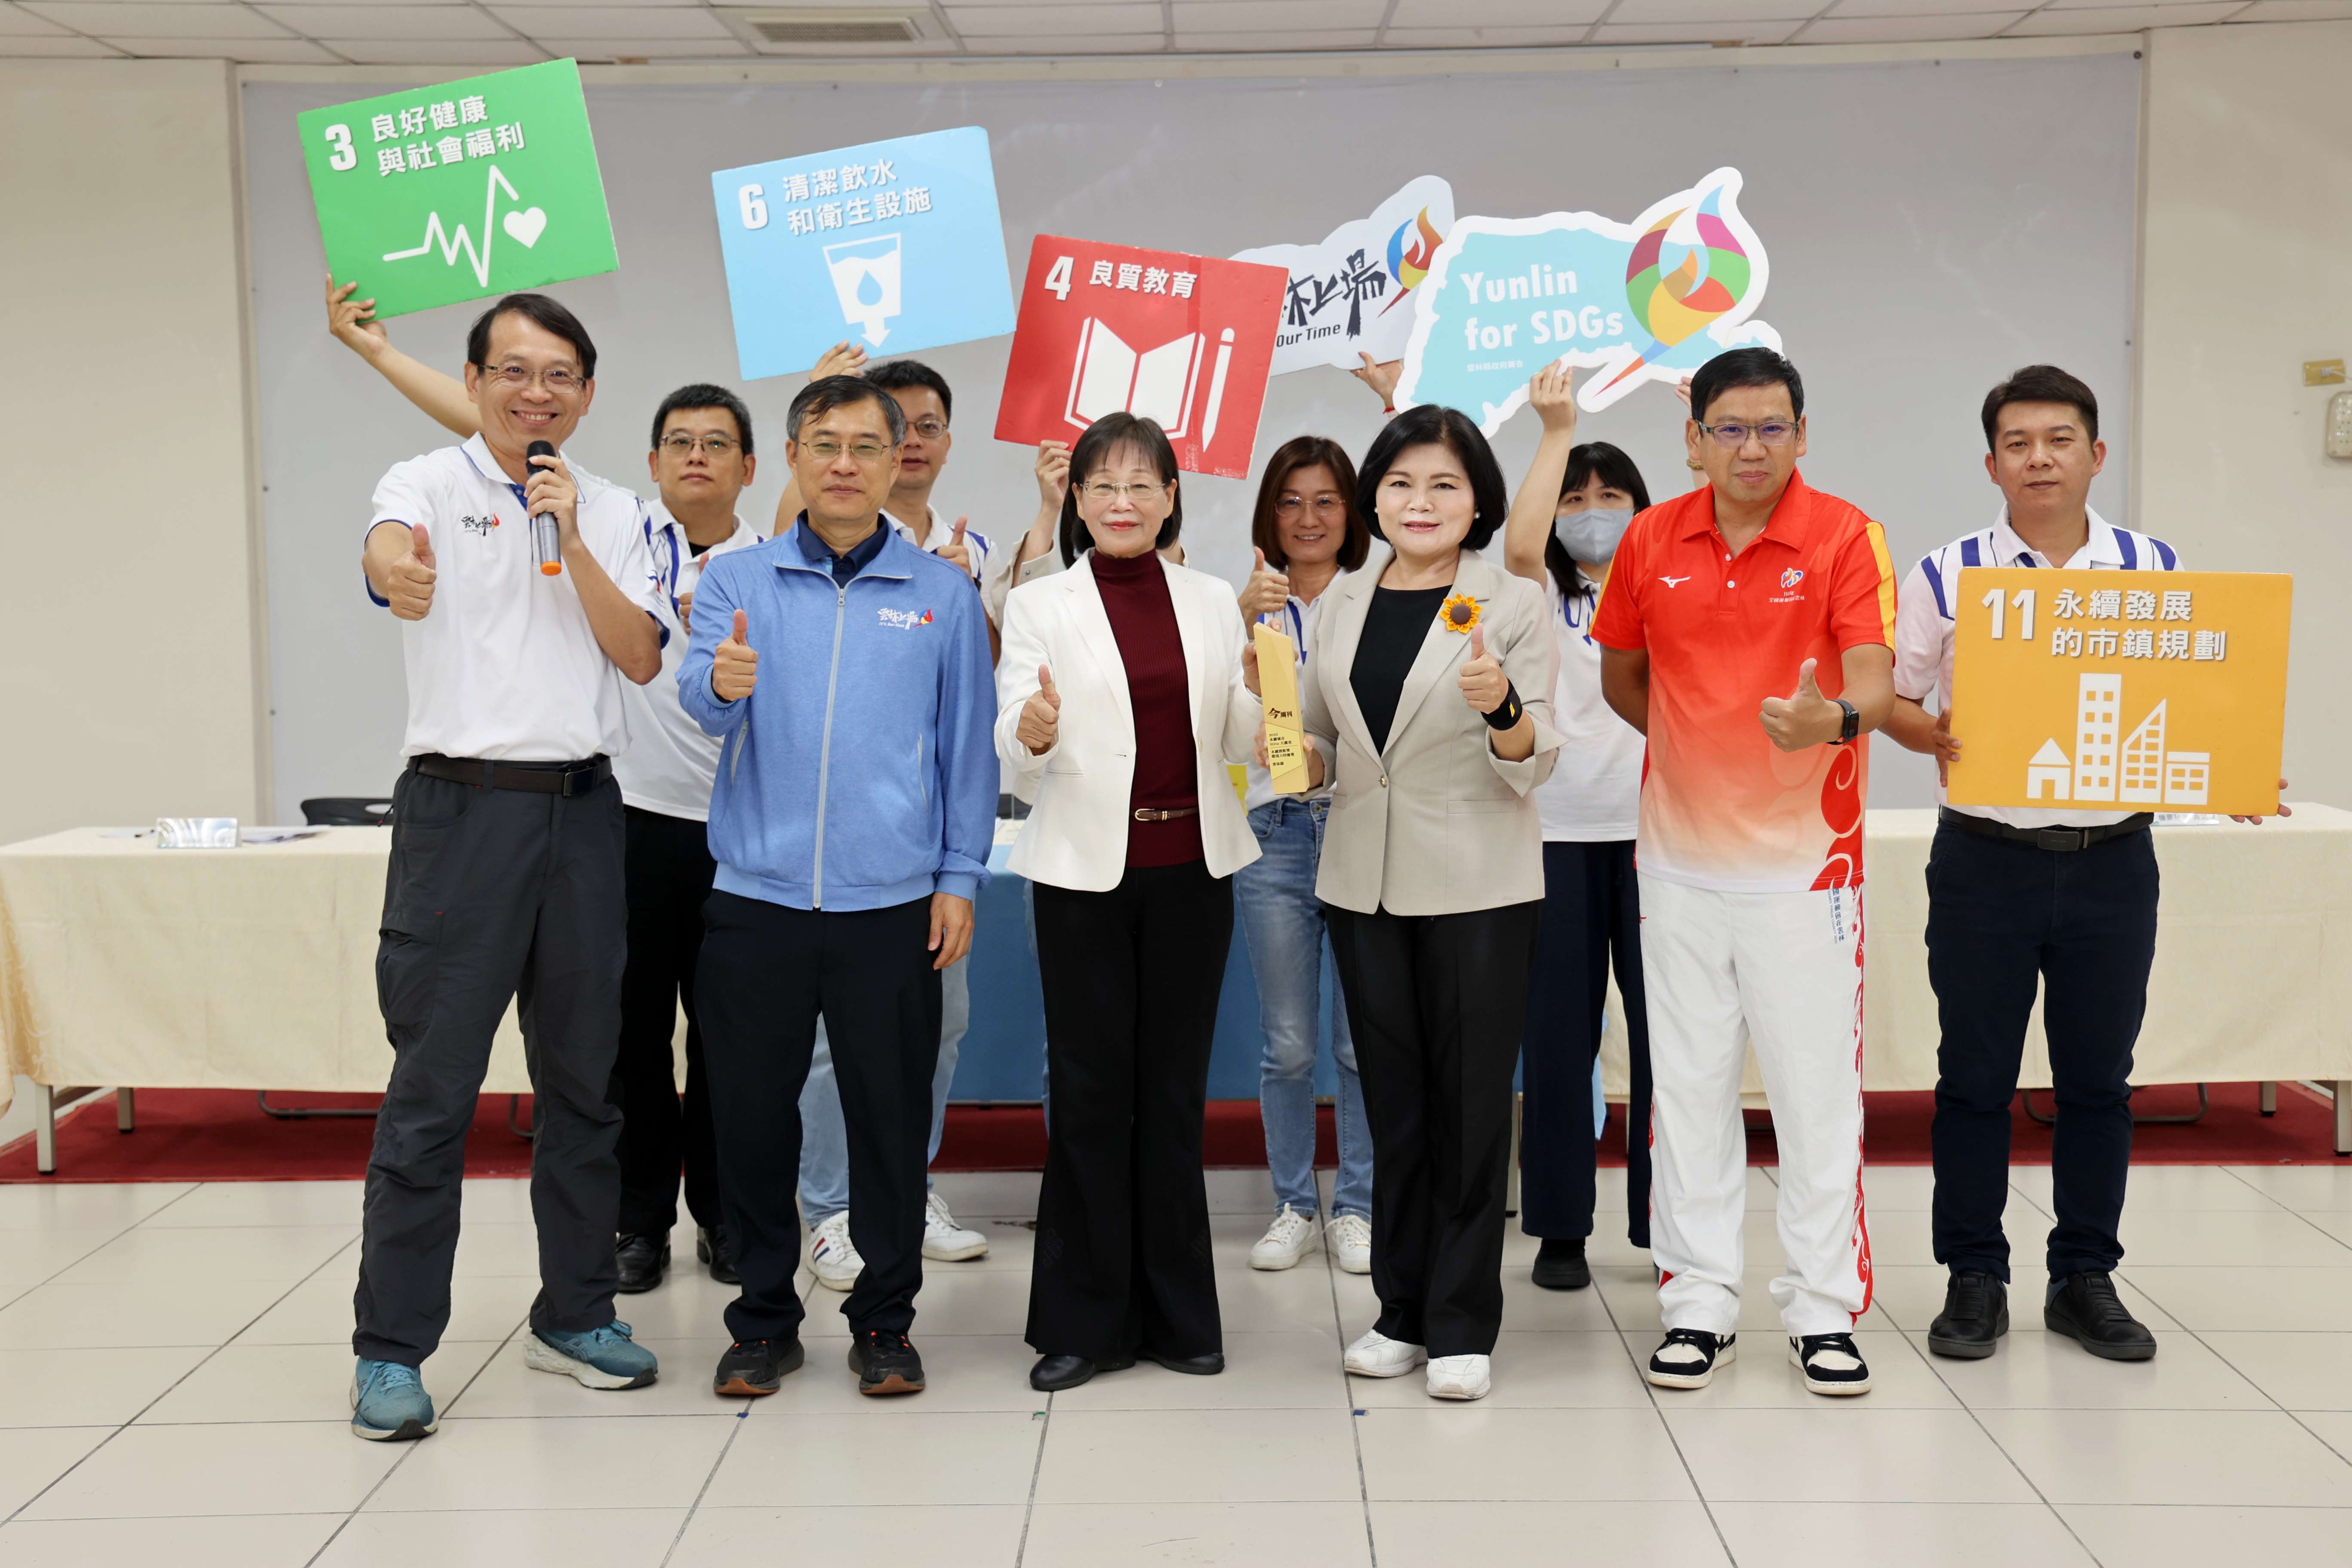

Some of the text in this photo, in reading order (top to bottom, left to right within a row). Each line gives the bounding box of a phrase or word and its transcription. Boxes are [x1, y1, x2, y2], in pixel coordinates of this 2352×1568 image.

[371, 95, 488, 143] 良好健康
[325, 123, 357, 171] 3
[377, 122, 525, 177] 與社會福利
[782, 159, 897, 202] 清潔飲水
[738, 183, 769, 230] 6
[787, 186, 932, 236] 和衛生設施
[1044, 256, 1074, 301] 4
[1089, 260, 1197, 299] 良質教育
[1460, 264, 1577, 304] Yunlin
[1276, 324, 1341, 347] Our Time
[1464, 305, 1623, 351] for SDGs
[1981, 589, 2035, 640] 11
[2053, 588, 2193, 621] 永續發展
[2052, 627, 2226, 661] 的市鎮規劃
[1267, 707, 1292, 719] 今周刊
